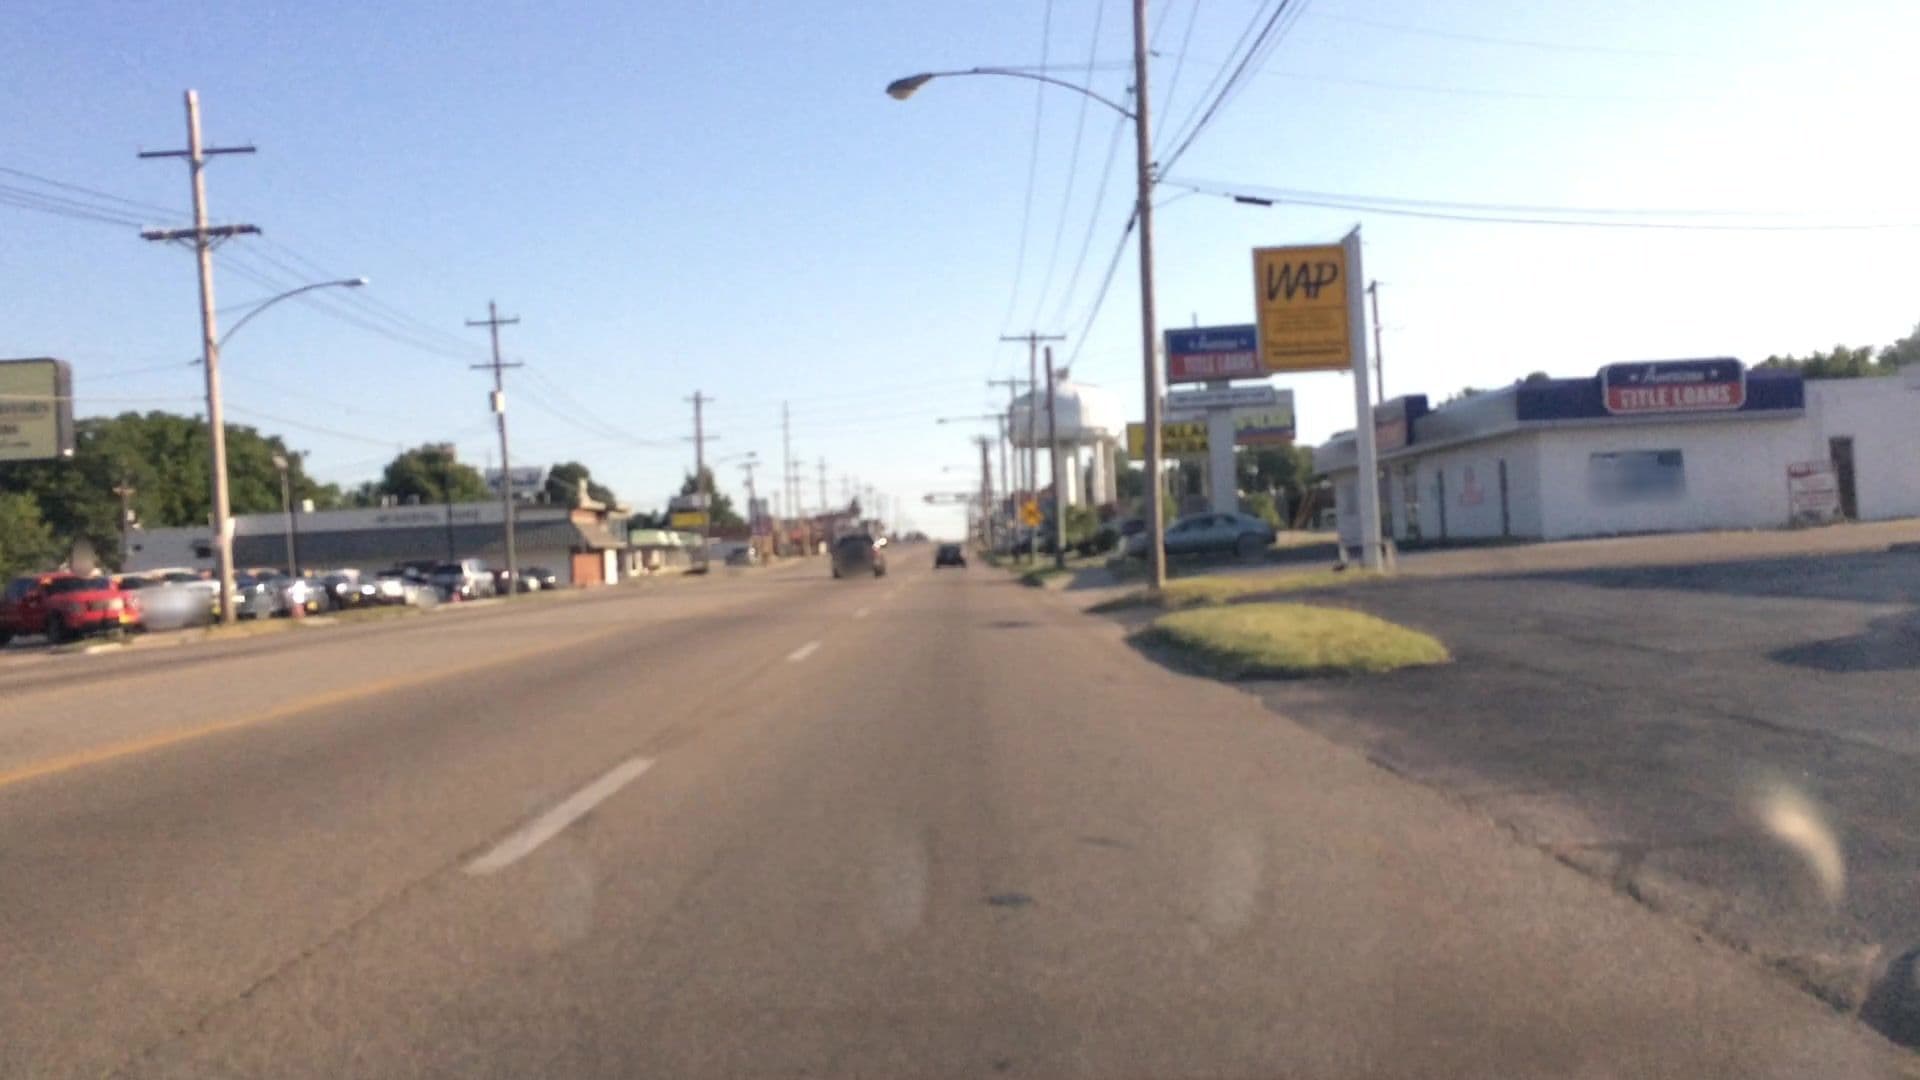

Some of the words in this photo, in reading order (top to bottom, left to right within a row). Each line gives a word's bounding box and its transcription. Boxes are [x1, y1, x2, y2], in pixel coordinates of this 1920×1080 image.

[1266, 260, 1339, 302] WAP
[1621, 387, 1667, 409] TITLE
[1673, 382, 1730, 406] LOANS
